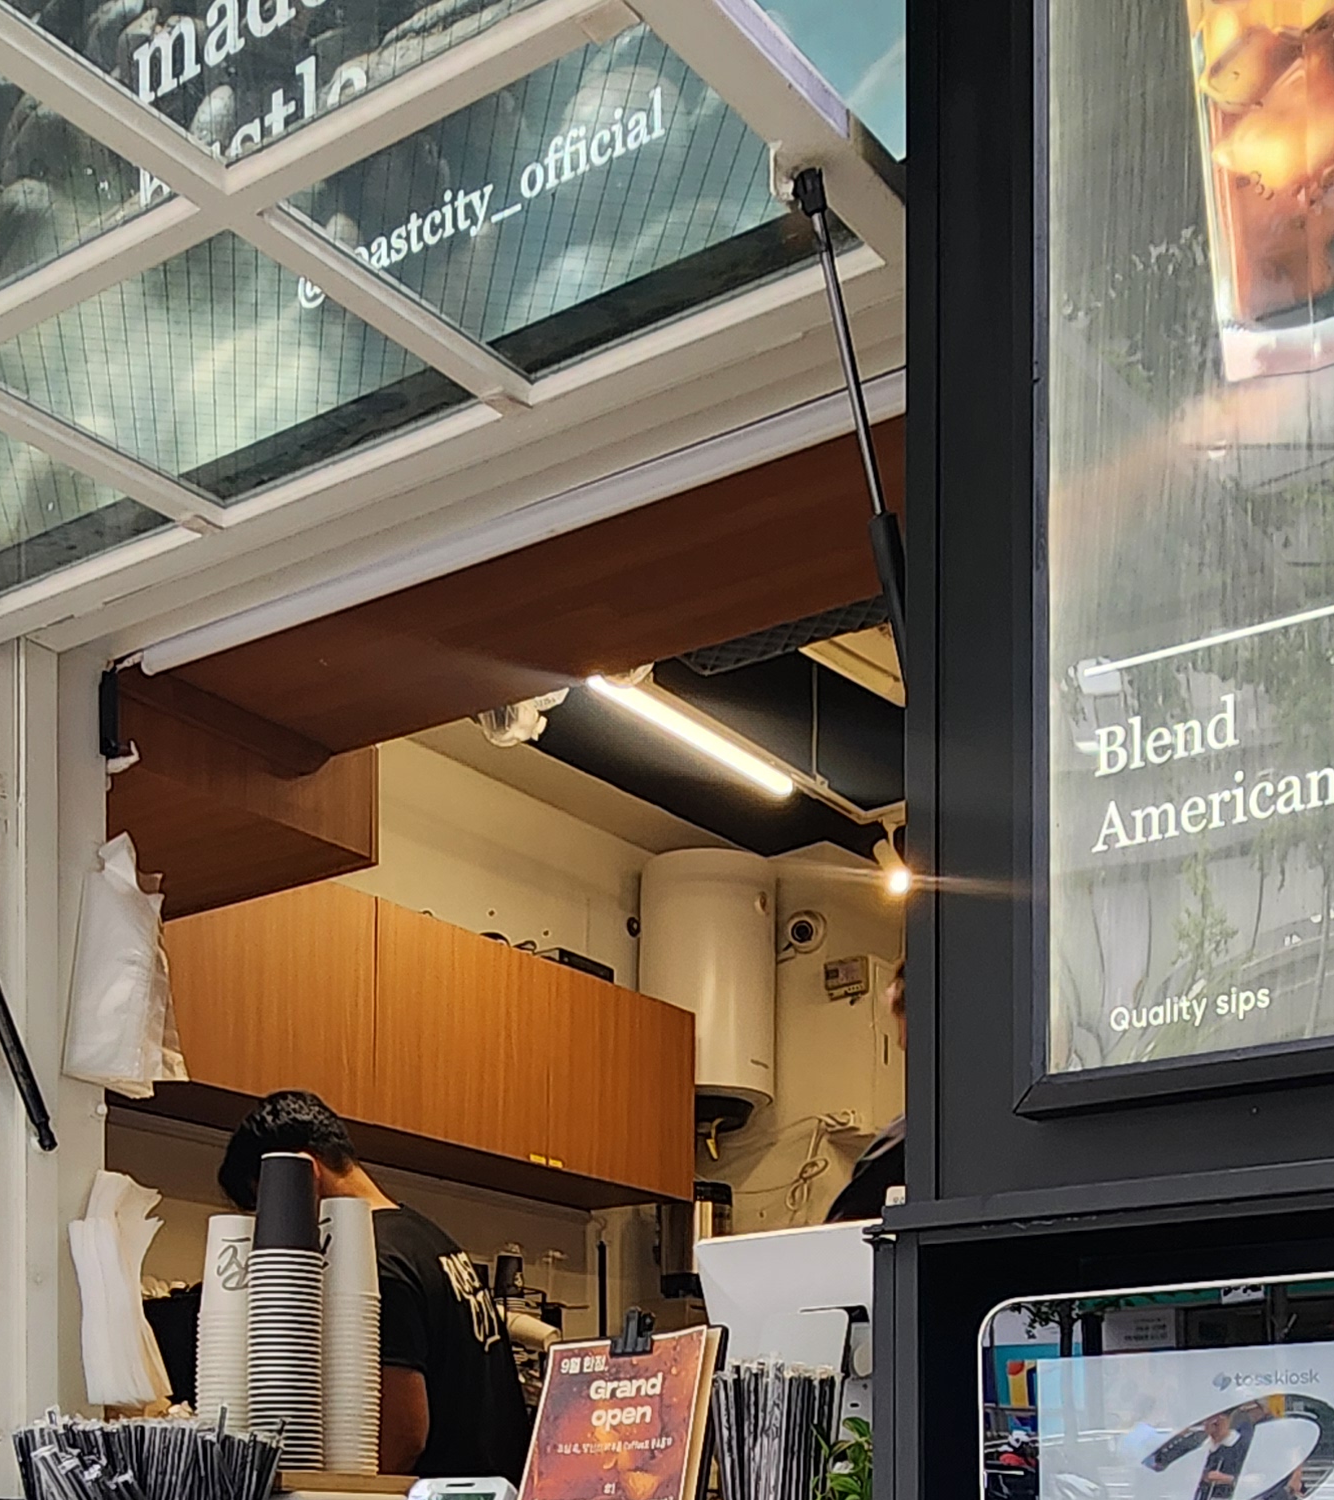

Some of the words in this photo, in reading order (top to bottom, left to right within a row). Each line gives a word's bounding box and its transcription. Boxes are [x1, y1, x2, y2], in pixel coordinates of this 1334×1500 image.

[297, 86, 666, 308] @astcity_official
[1094, 693, 1240, 778] Blend
[1109, 991, 1208, 1034] Quality
[1216, 985, 1271, 1023] sips
[589, 1372, 664, 1400] Grand
[591, 1404, 652, 1432] open
